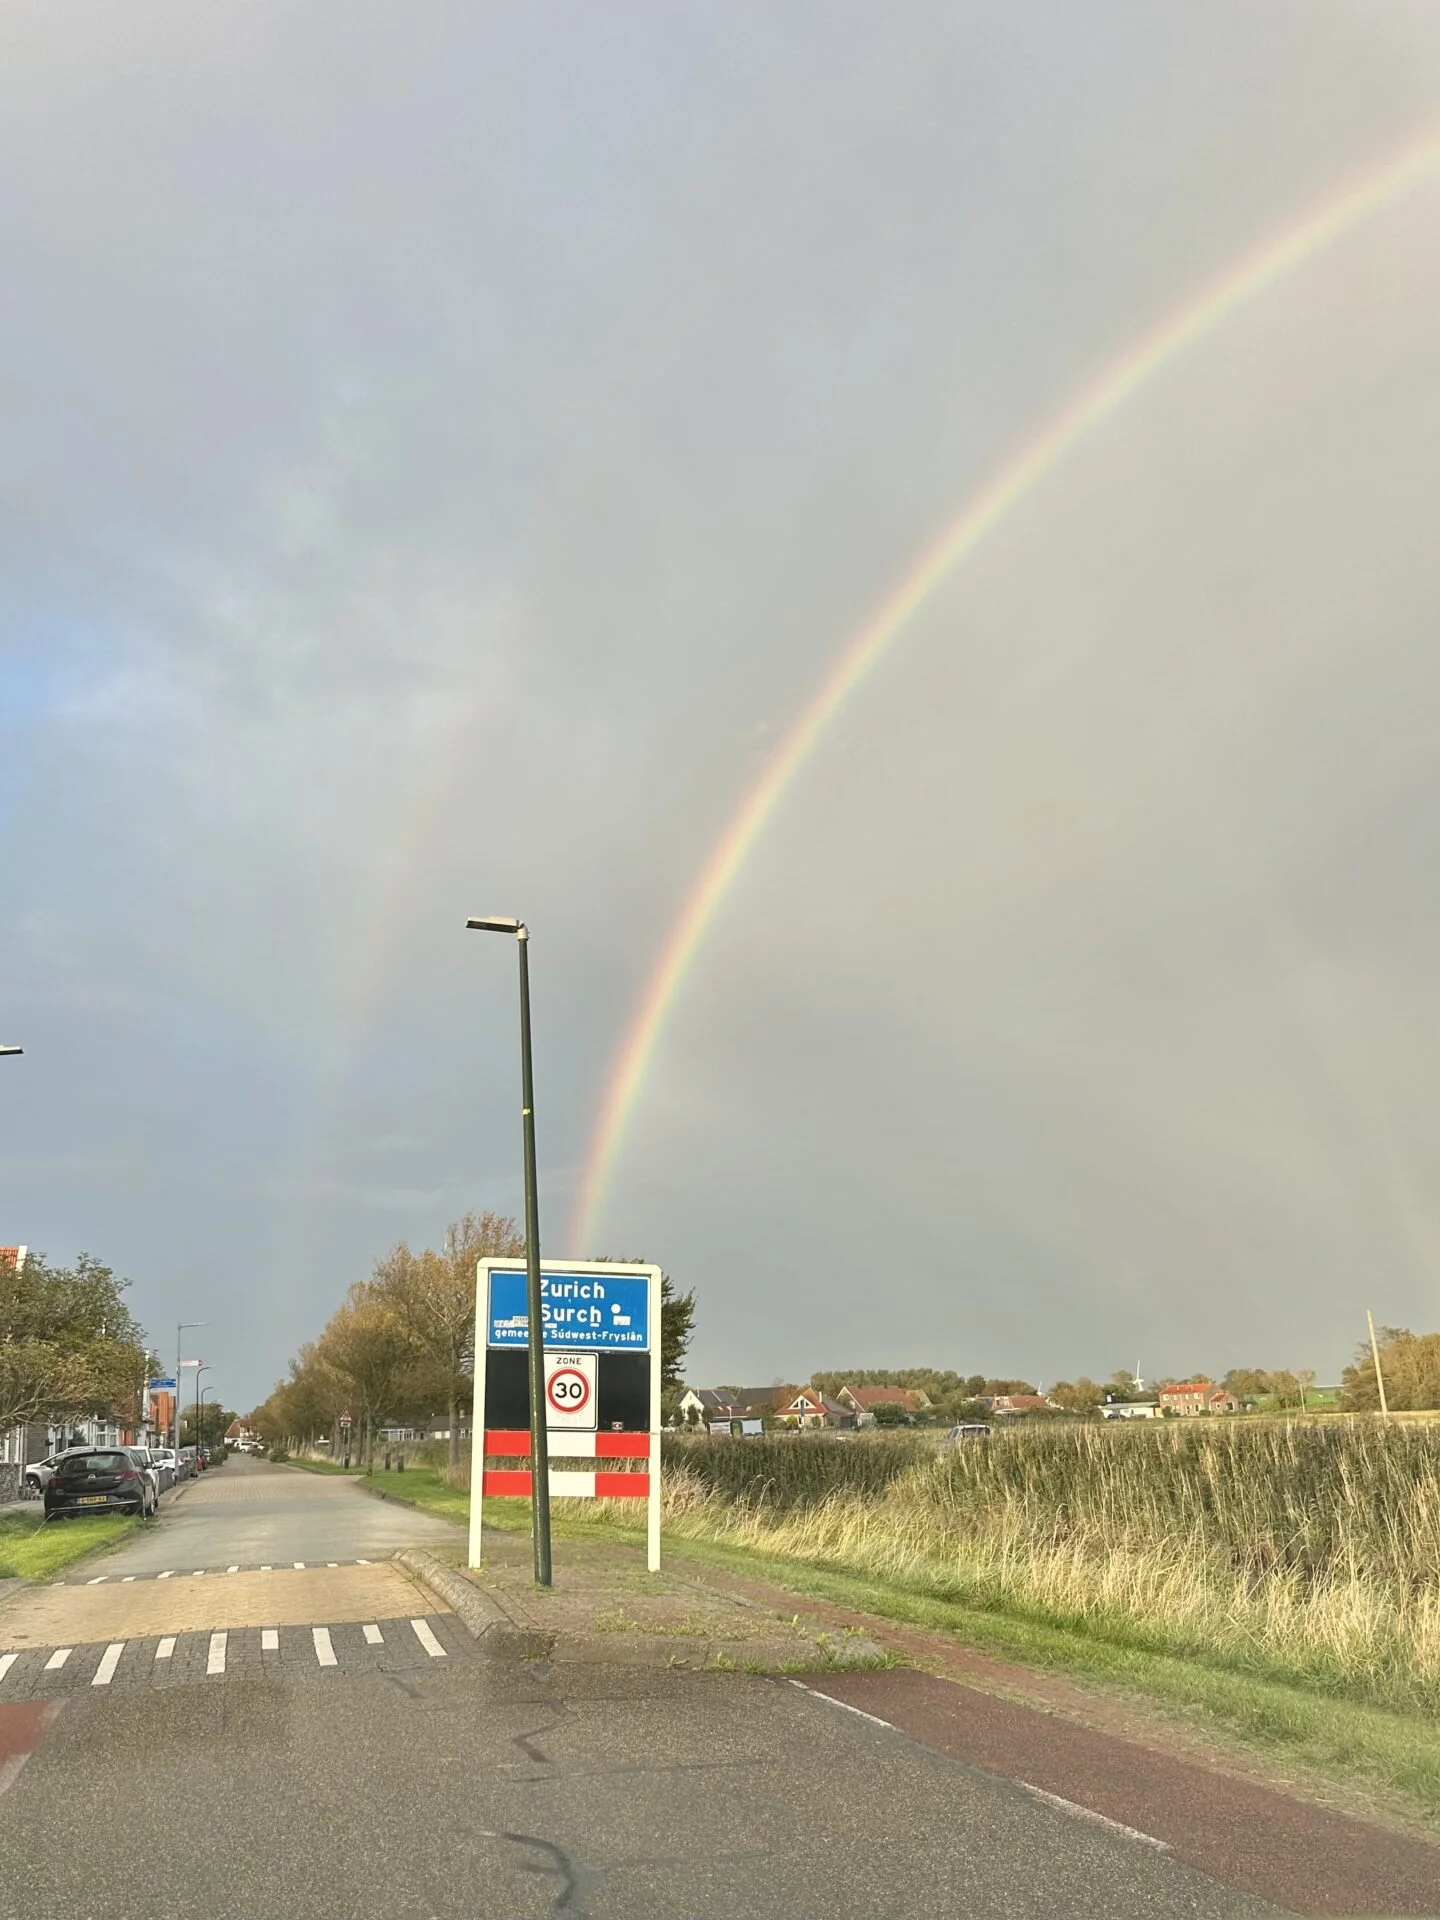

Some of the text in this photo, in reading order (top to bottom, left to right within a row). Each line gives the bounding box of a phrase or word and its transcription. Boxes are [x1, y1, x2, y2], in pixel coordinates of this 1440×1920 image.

[540, 1279, 604, 1298] Zurich
[541, 1303, 601, 1322] Surch
[495, 1328, 643, 1342] gemeee Súdwest-Fryslân
[556, 1357, 581, 1365] ZONE
[555, 1382, 582, 1398] 30
